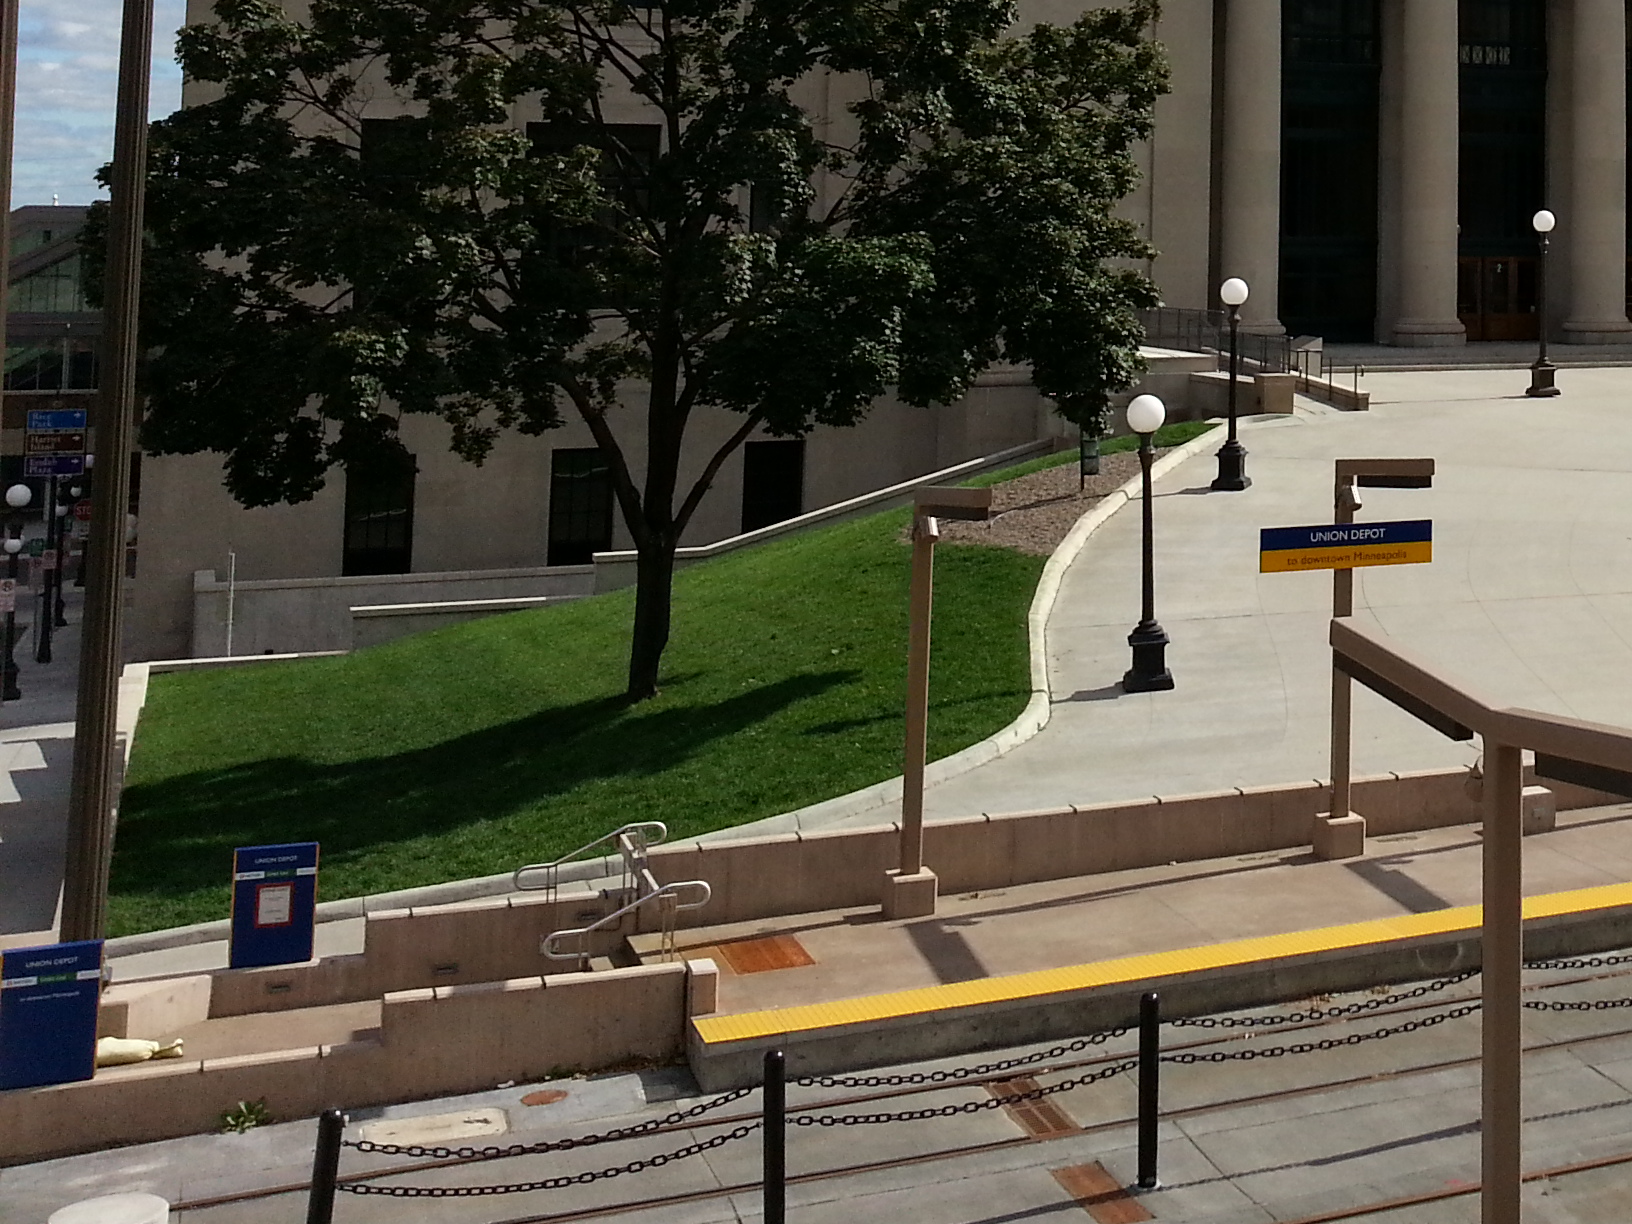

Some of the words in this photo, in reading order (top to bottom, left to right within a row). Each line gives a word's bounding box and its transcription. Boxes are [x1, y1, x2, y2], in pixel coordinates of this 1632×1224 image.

[1310, 530, 1348, 542] UNION
[1350, 528, 1386, 540] DEPOT
[1287, 557, 1298, 566] to
[1301, 553, 1351, 565] downtown
[1353, 549, 1407, 562] Minneapolis
[25, 959, 52, 968] UNION
[53, 956, 78, 965] DEPOT
